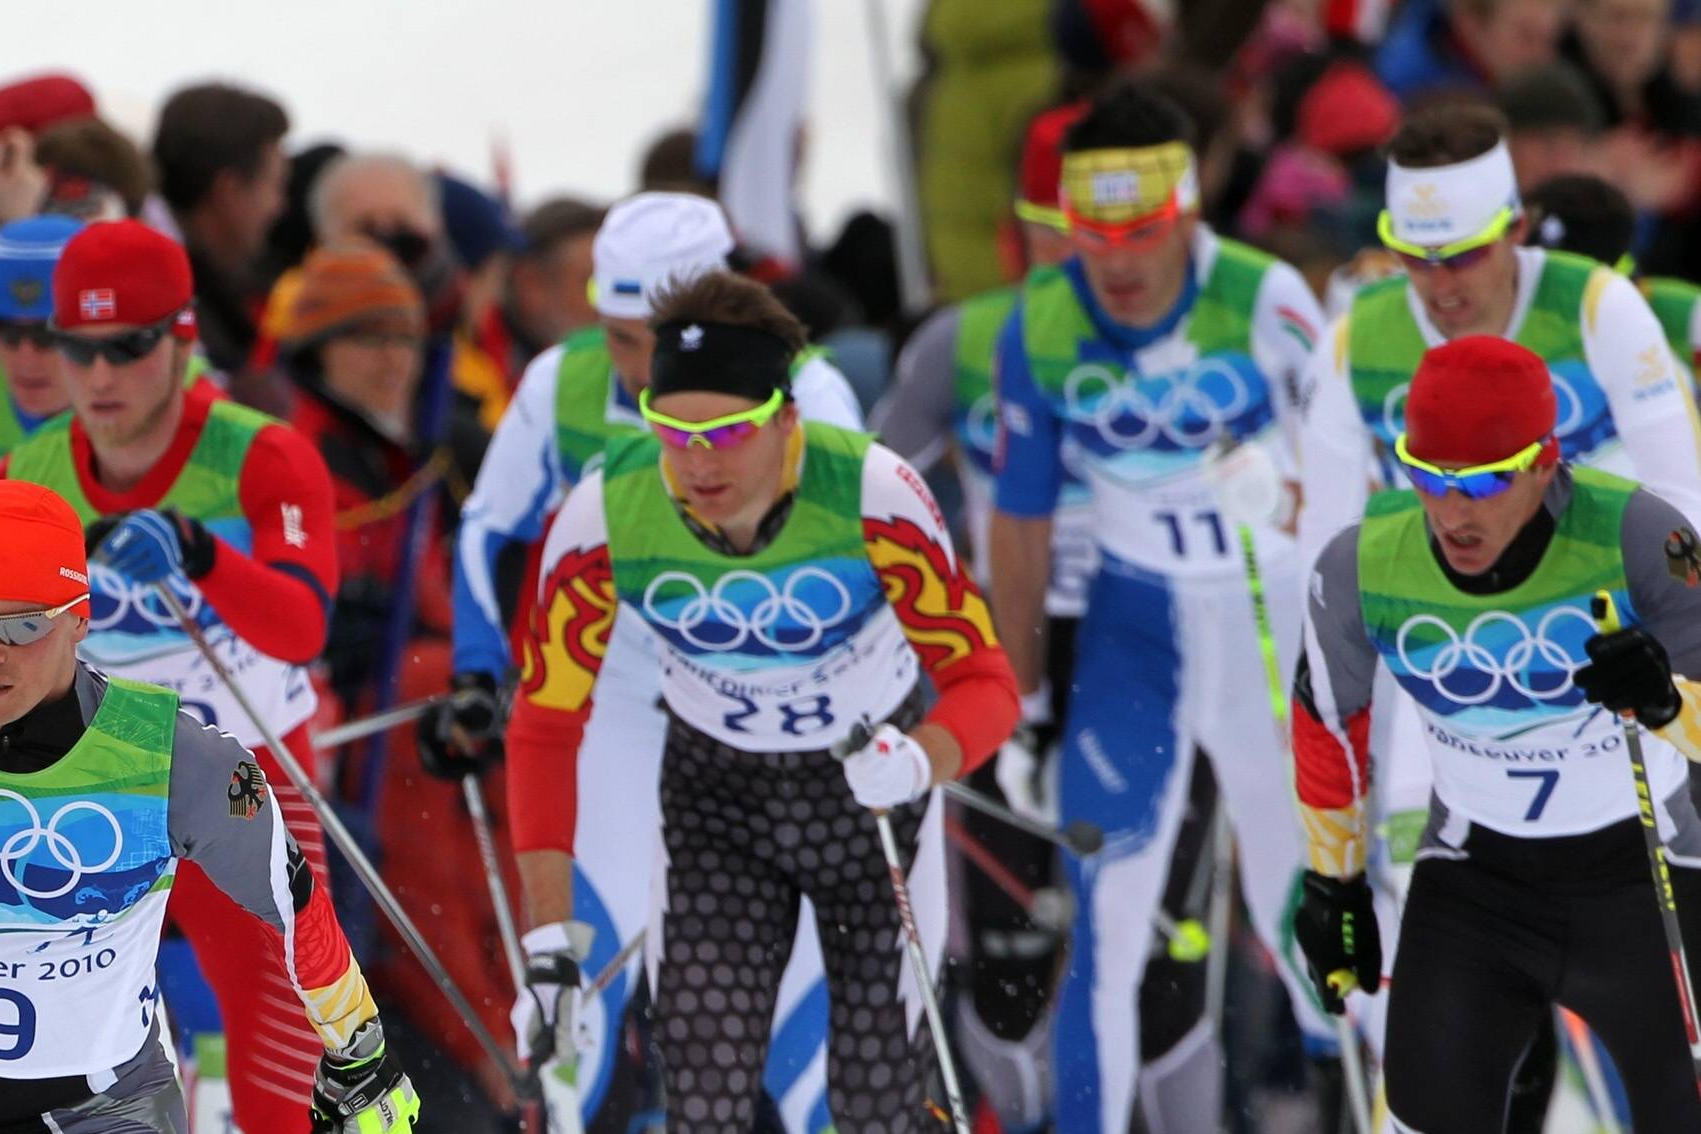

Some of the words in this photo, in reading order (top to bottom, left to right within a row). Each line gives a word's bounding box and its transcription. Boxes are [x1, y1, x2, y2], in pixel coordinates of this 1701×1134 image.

[1154, 511, 1231, 558] 11
[1580, 735, 1621, 758] 20
[1506, 768, 1560, 823] 7
[38, 948, 117, 981] 2010
